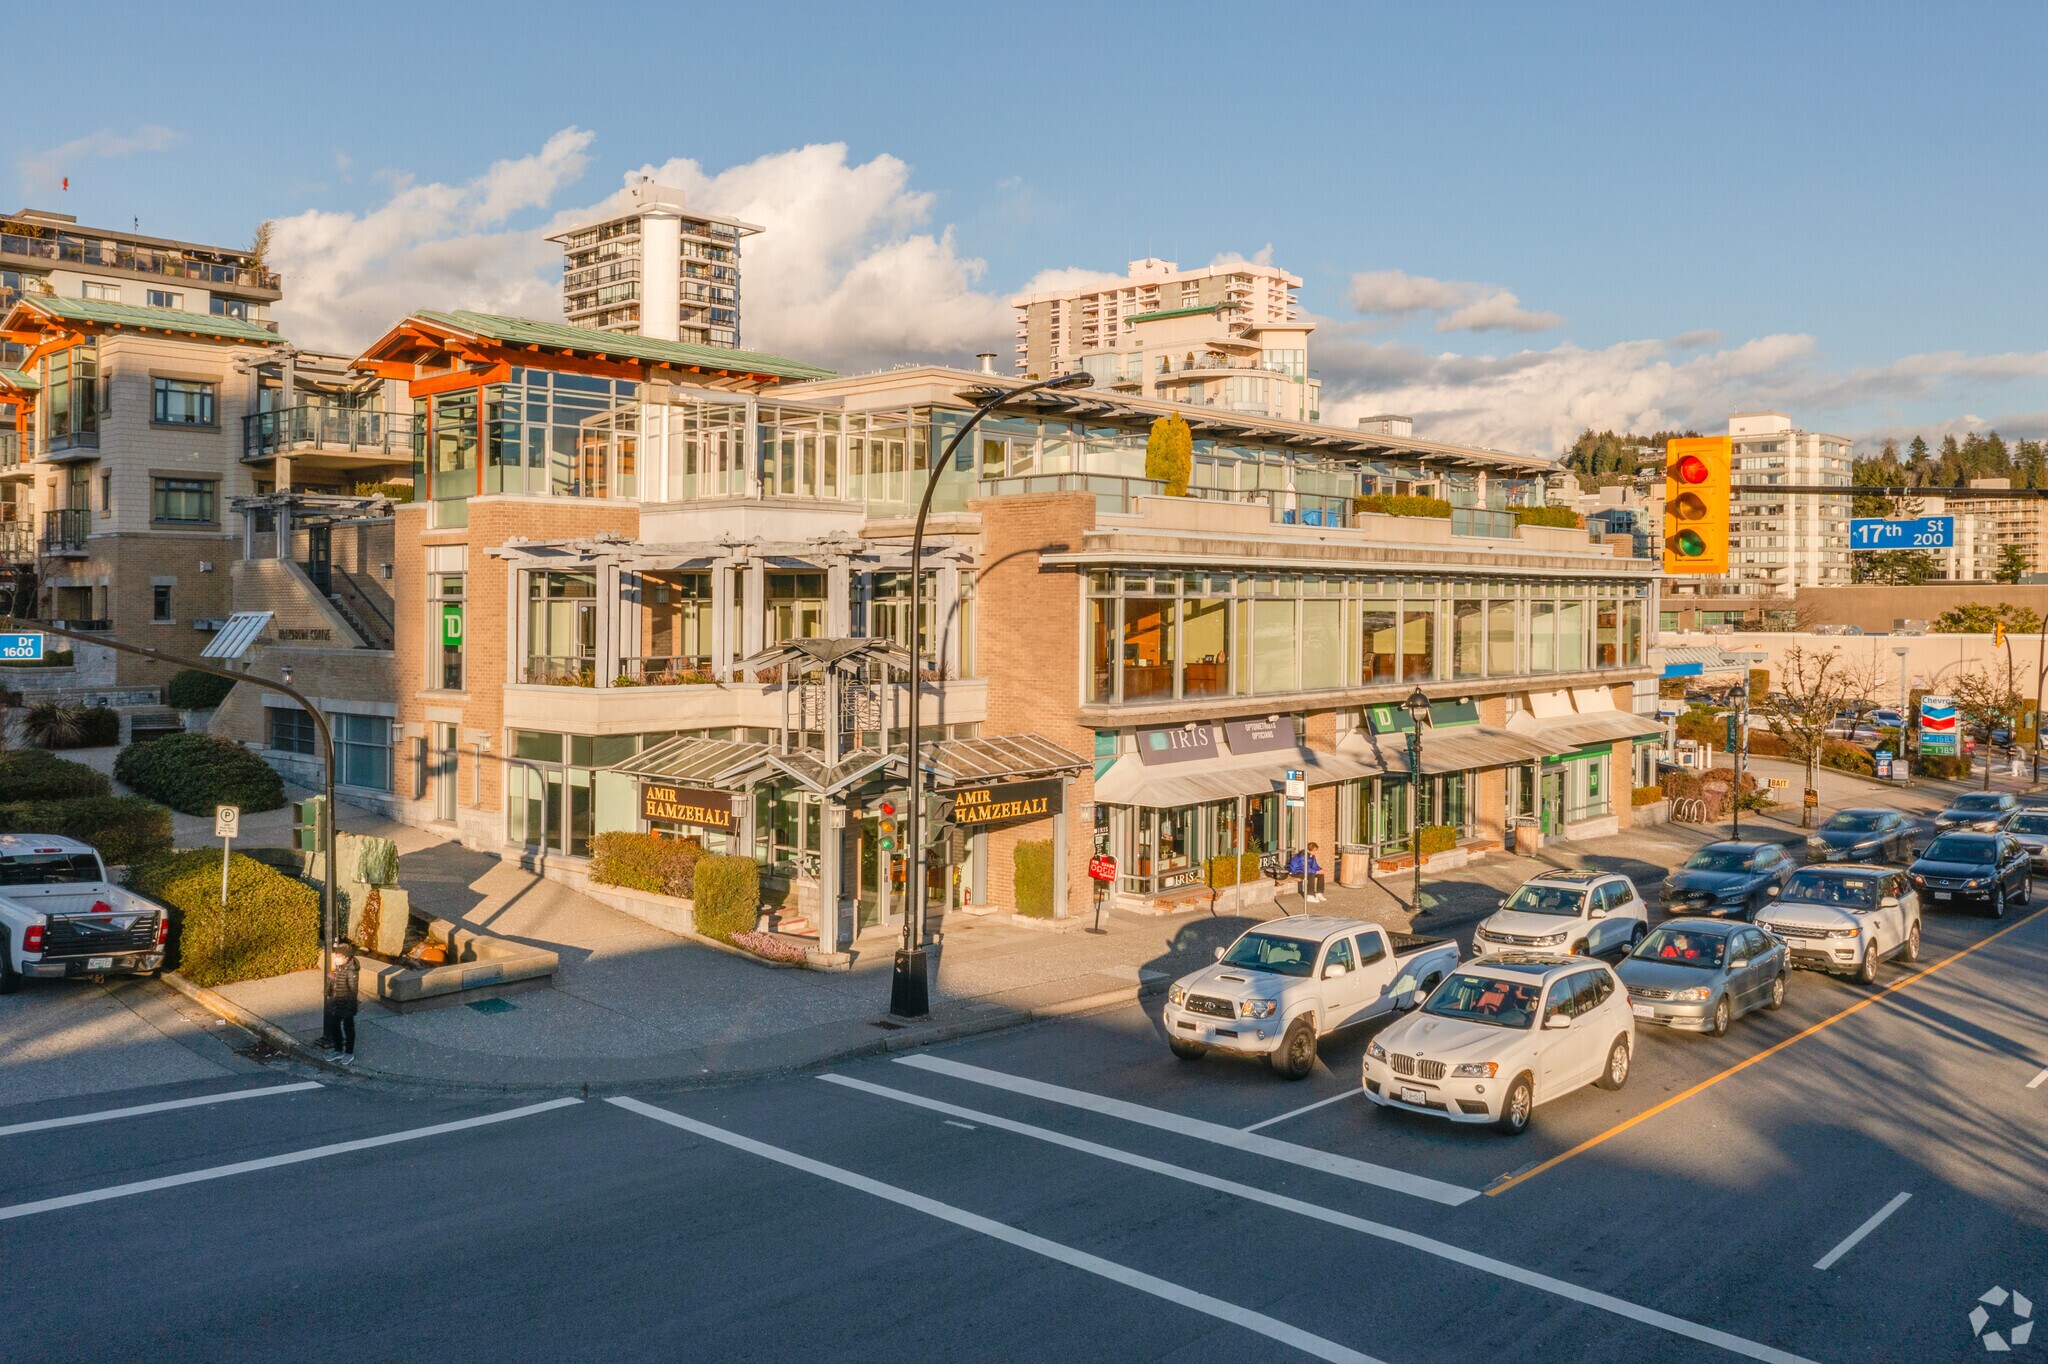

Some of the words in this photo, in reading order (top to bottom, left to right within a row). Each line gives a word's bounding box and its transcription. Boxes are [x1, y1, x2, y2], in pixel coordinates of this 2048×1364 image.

[1858, 524, 1902, 544] 17th
[1927, 519, 1944, 532] St
[1913, 533, 1944, 546] 200
[444, 614, 462, 638] TD
[18, 636, 35, 647] Dr
[3, 647, 35, 657] 1600
[1375, 708, 1392, 726] TD
[1169, 727, 1209, 750] IRIS
[1771, 779, 1788, 787] BAIT
[646, 786, 678, 803] AMIR
[954, 789, 992, 807] AMIR
[645, 800, 731, 827] HAMZEHALI
[954, 797, 1048, 824] HAMZEHALI
[1260, 855, 1279, 868] IRS
[1175, 871, 1195, 886] IRIS
